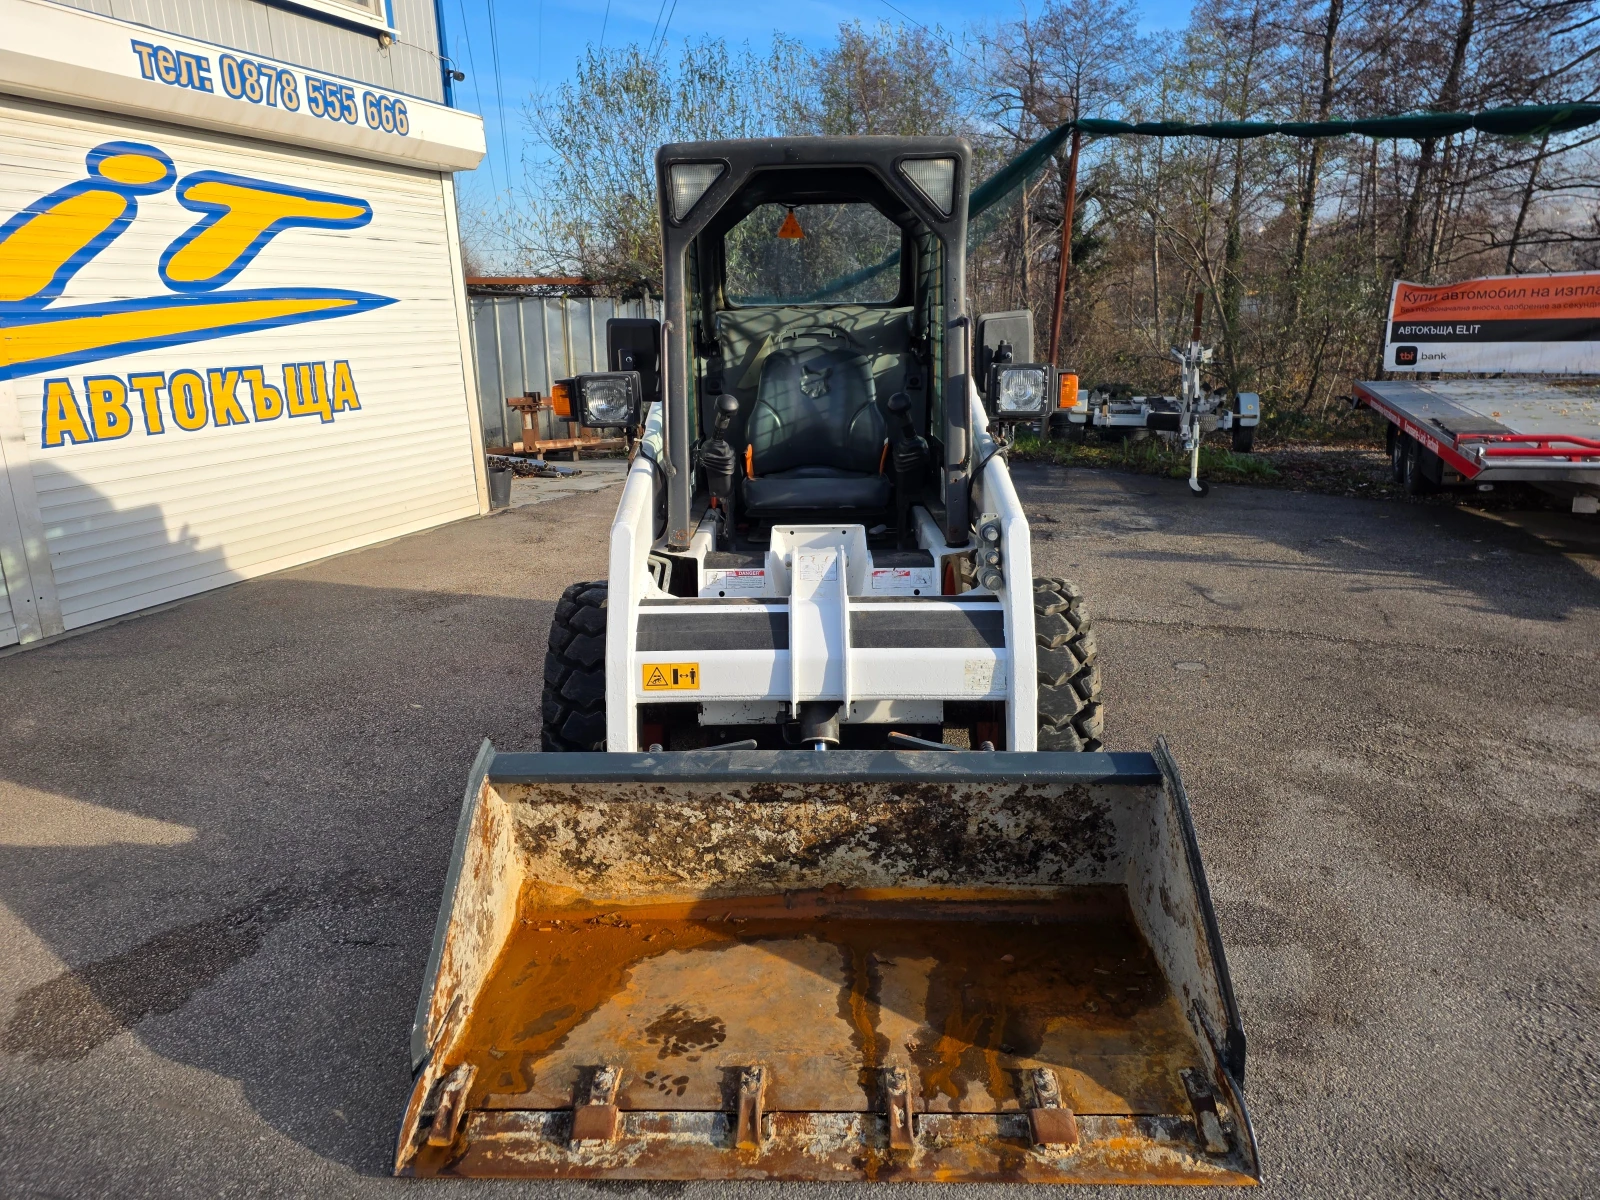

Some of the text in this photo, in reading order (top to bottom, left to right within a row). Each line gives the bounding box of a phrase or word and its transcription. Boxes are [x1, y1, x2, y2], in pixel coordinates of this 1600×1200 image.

[131, 39, 409, 136] тел: 0878 555 666
[1403, 291, 1438, 304] Купи
[1441, 287, 1527, 301] автомобил
[1531, 287, 1550, 298] на
[1415, 304, 1471, 313] първоначална
[1471, 304, 1502, 312] вноска,
[1503, 302, 1550, 312] одобрение
[1551, 302, 1562, 310] за
[1398, 325, 1481, 336] АВТОКЪЩА ELIT
[1400, 352, 1447, 361] tbi bank
[41, 360, 362, 449] АВТОКЪЩА
